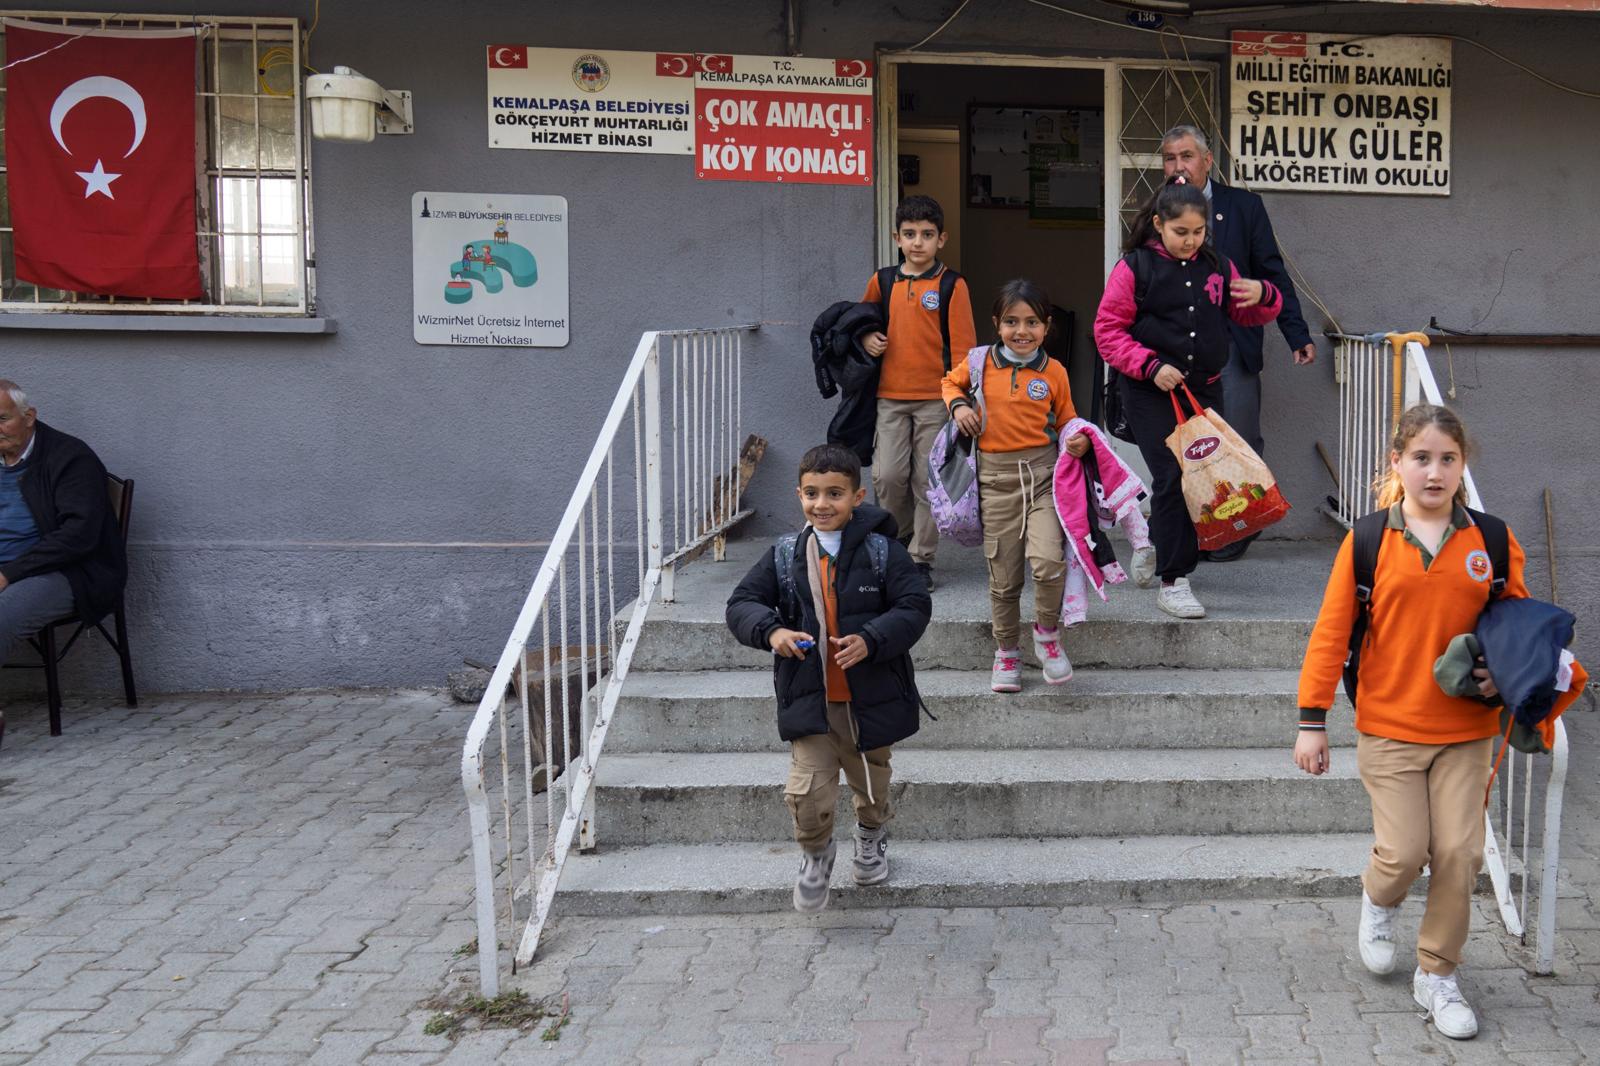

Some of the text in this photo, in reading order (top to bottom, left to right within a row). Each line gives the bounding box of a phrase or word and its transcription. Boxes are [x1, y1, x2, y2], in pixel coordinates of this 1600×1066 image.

[1137, 11, 1156, 22] 136
[772, 60, 796, 71] T.C.
[1236, 57, 1451, 88] MİLLİ EĞİTİM BAKANLIĞI
[700, 72, 774, 86] KEMALPAŞA
[493, 97, 690, 116] KEMALPAŞA BELEDİYESİ
[1247, 87, 1438, 127] ŞEHİT ONBAŞI
[495, 113, 689, 132] GÖKÇEYURT MUHTARLIĞI
[705, 98, 863, 137] ÇOK AMAÇLI
[531, 129, 653, 147] HİZMET BİNASI
[1240, 122, 1443, 162] HALUK GÜLER
[702, 137, 866, 176] KÖY KONAĞI
[1234, 158, 1448, 187] İLKÖĞRETİM OKULU
[418, 314, 565, 328] WizmirNet Ücretsiz İnternet
[451, 333, 533, 345] Hizmet Noktası
